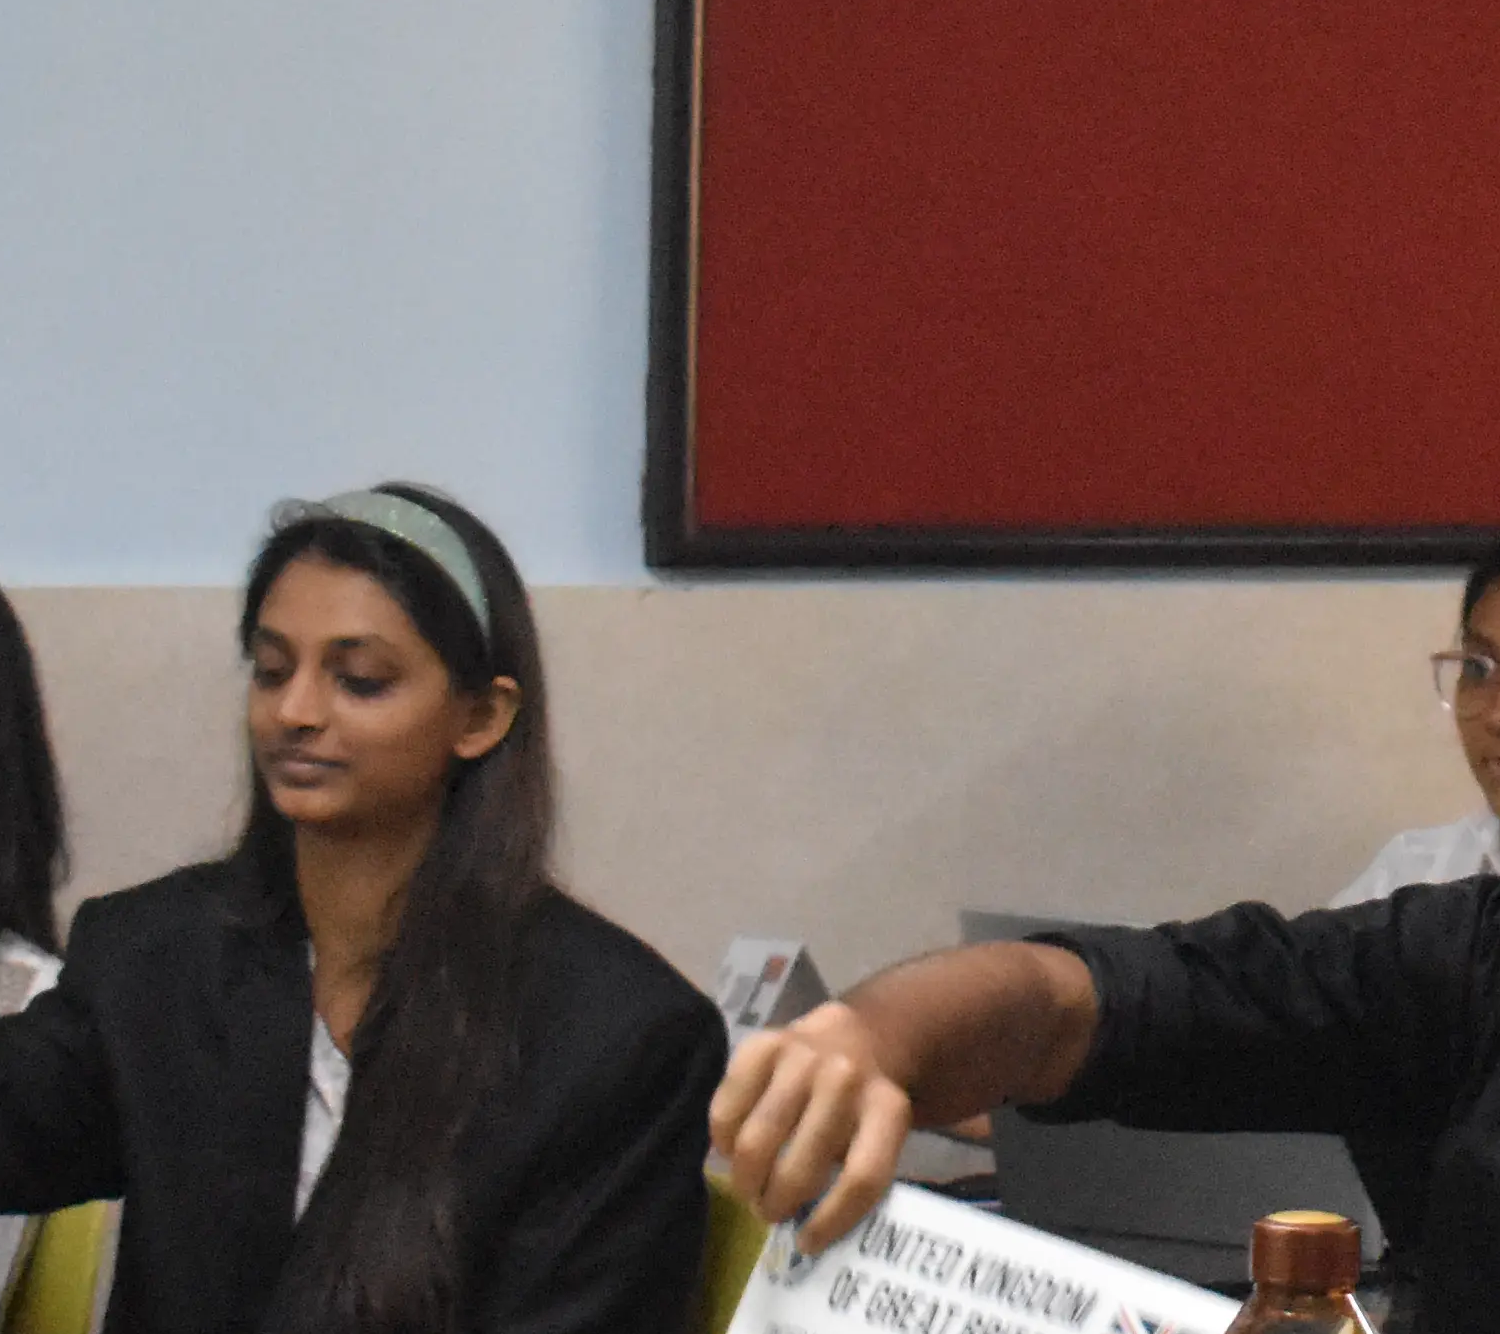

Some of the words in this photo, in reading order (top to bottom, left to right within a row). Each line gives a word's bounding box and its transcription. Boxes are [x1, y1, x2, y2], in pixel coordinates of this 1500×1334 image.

[828, 1266, 870, 1312] OF
[859, 1216, 965, 1287] UNITED
[958, 1248, 1099, 1330] KINGDOM
